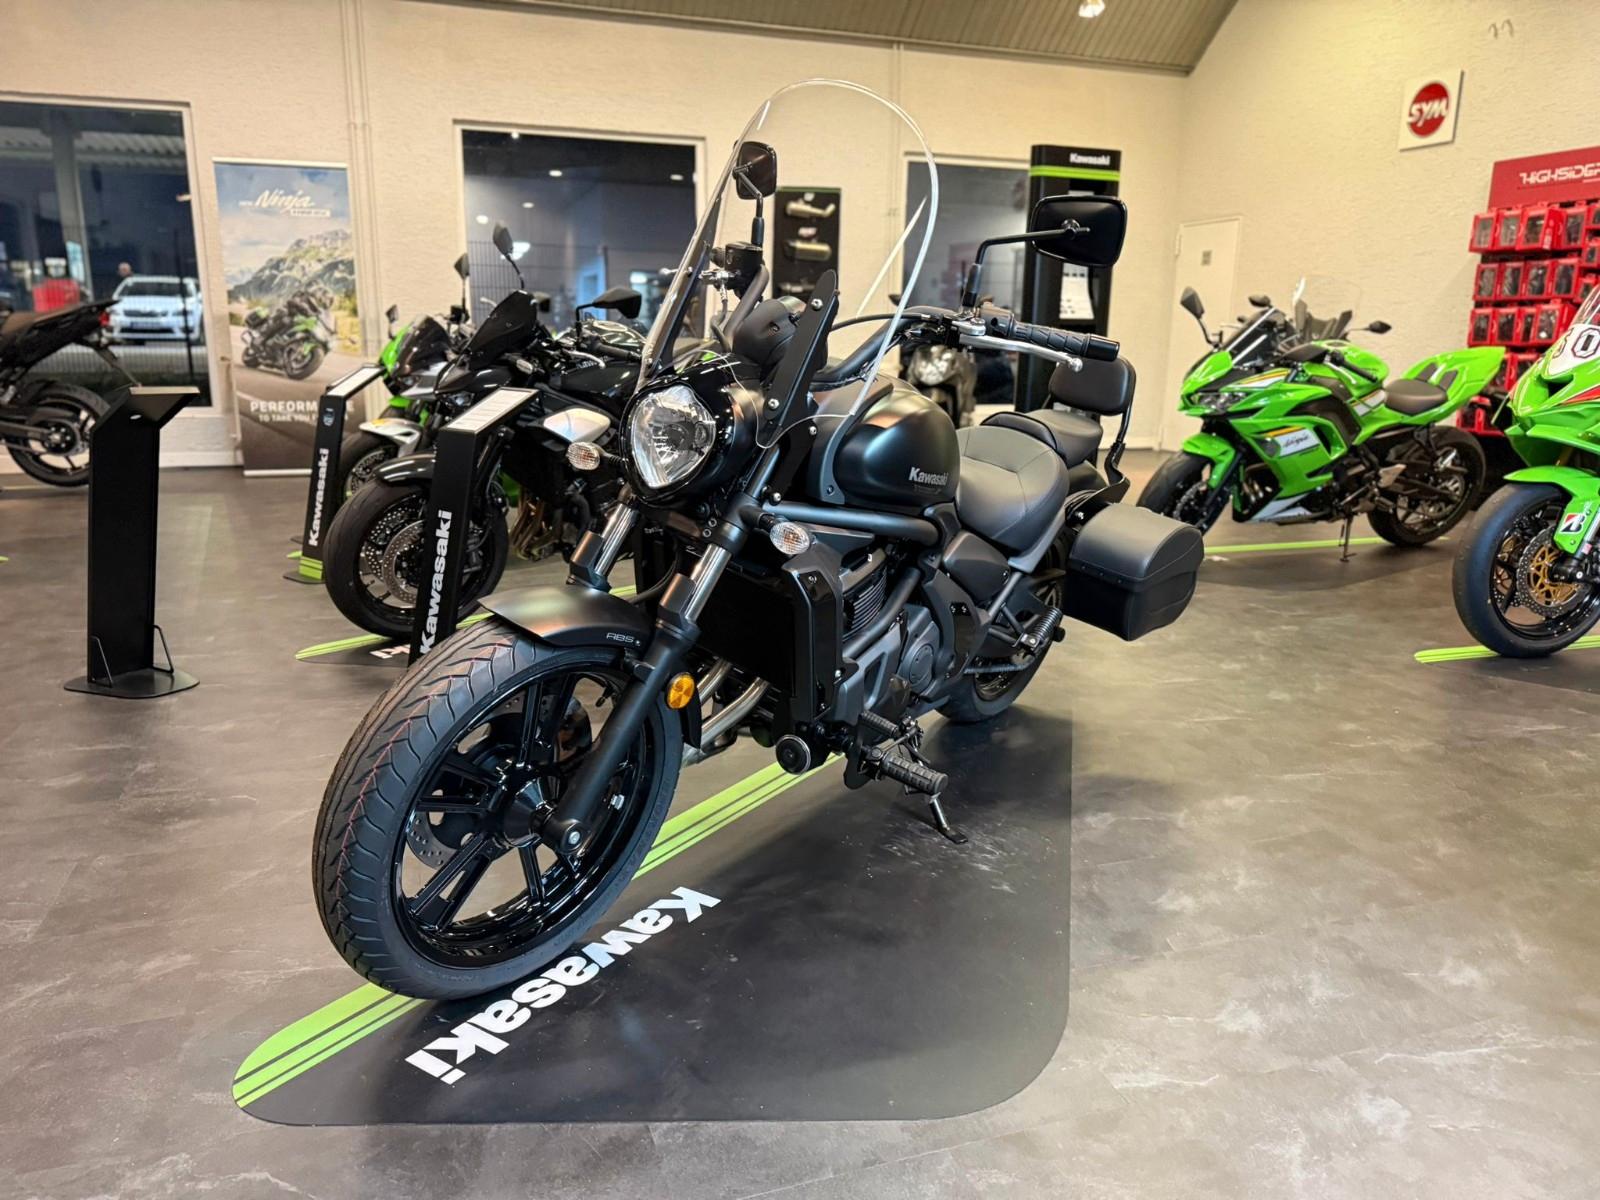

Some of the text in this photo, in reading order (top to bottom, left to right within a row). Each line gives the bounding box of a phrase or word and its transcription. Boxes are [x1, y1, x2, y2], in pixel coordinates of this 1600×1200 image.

[1407, 98, 1449, 128] SYM
[255, 188, 316, 213] Ninja
[250, 400, 355, 412] PERFORME
[909, 466, 949, 486] Kawasaki
[309, 448, 329, 546] Kawasaki
[420, 509, 453, 655] Kawasaki
[606, 632, 635, 643] ABS
[405, 886, 722, 1085] Kawasaki
